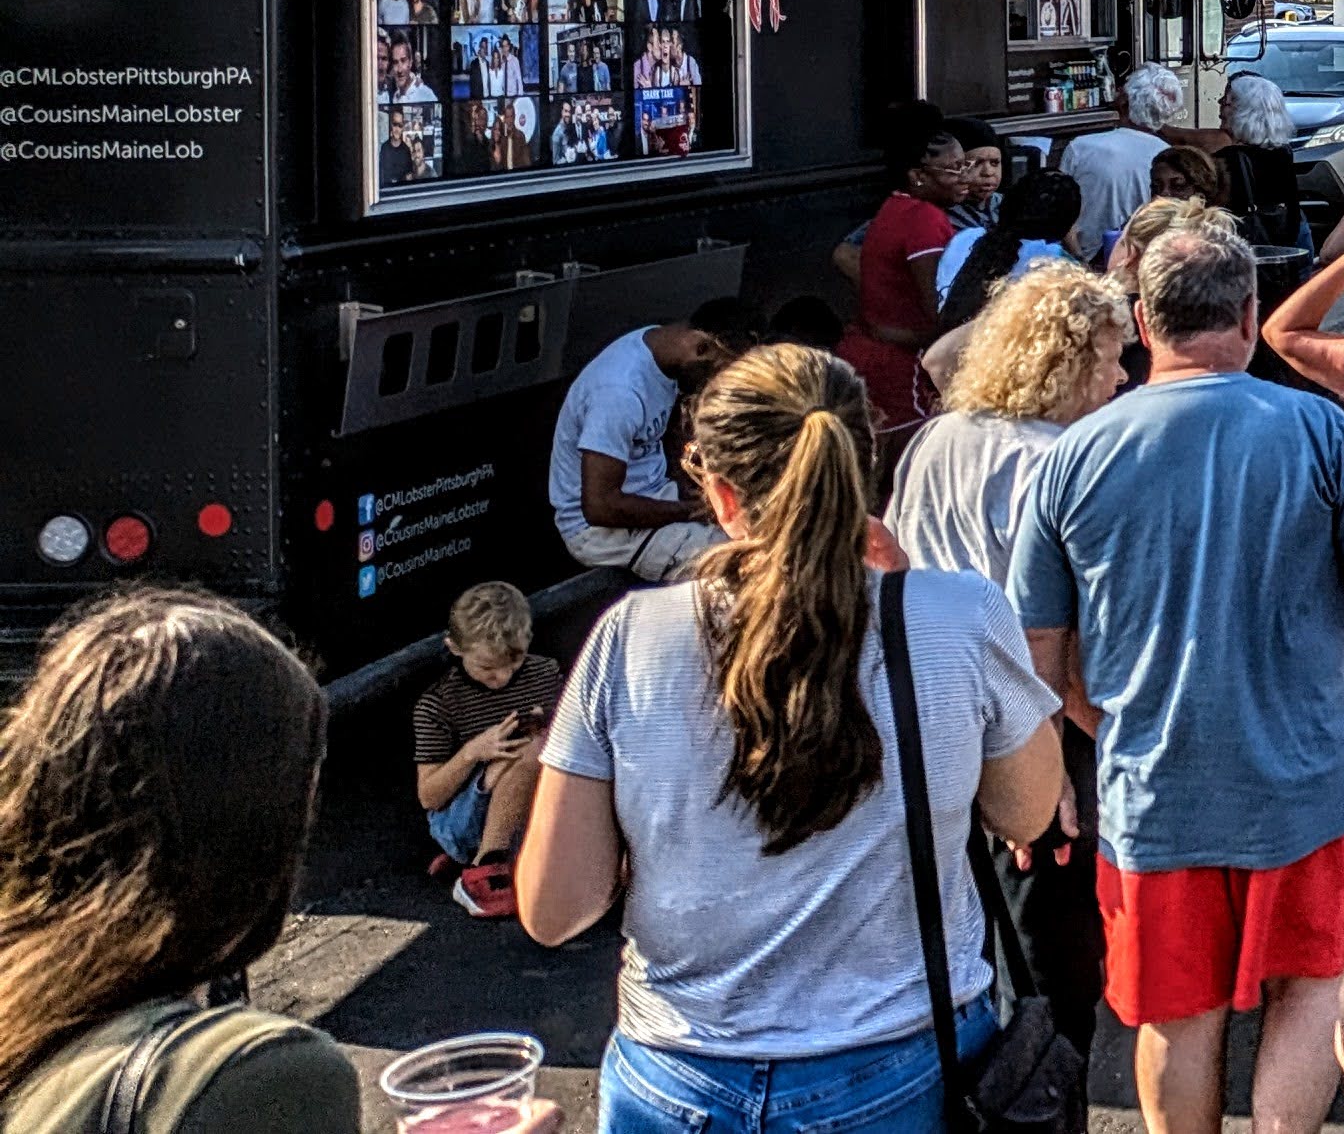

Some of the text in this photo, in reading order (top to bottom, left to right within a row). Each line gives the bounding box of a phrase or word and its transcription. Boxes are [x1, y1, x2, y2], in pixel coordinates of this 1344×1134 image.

[0, 67, 252, 89] @CMLobsterPittsburghPA
[0, 104, 242, 125] @CousinsMaineLobster
[0, 141, 204, 161] @CousinsMaineLob
